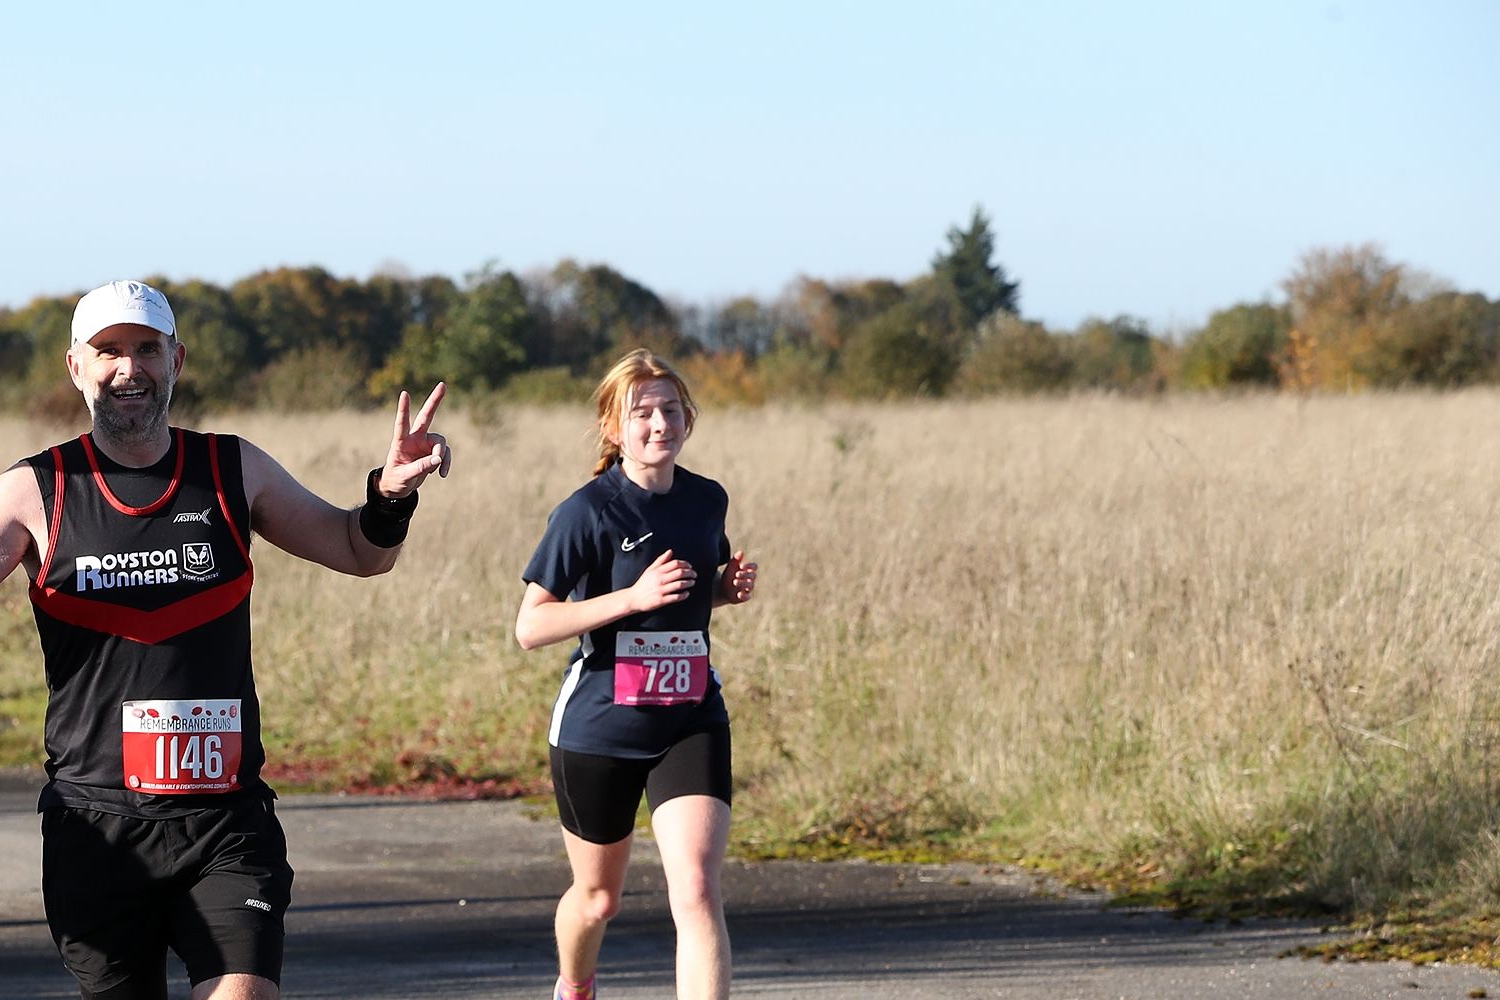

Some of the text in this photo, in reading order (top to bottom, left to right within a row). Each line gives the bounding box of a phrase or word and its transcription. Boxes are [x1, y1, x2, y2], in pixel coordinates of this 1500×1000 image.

[75, 549, 178, 579] ROYSTON
[76, 566, 180, 592] RUNNERS
[642, 659, 691, 693] 728
[140, 717, 232, 730] REMEMBRANCE RUNS
[155, 734, 224, 779] 1146
